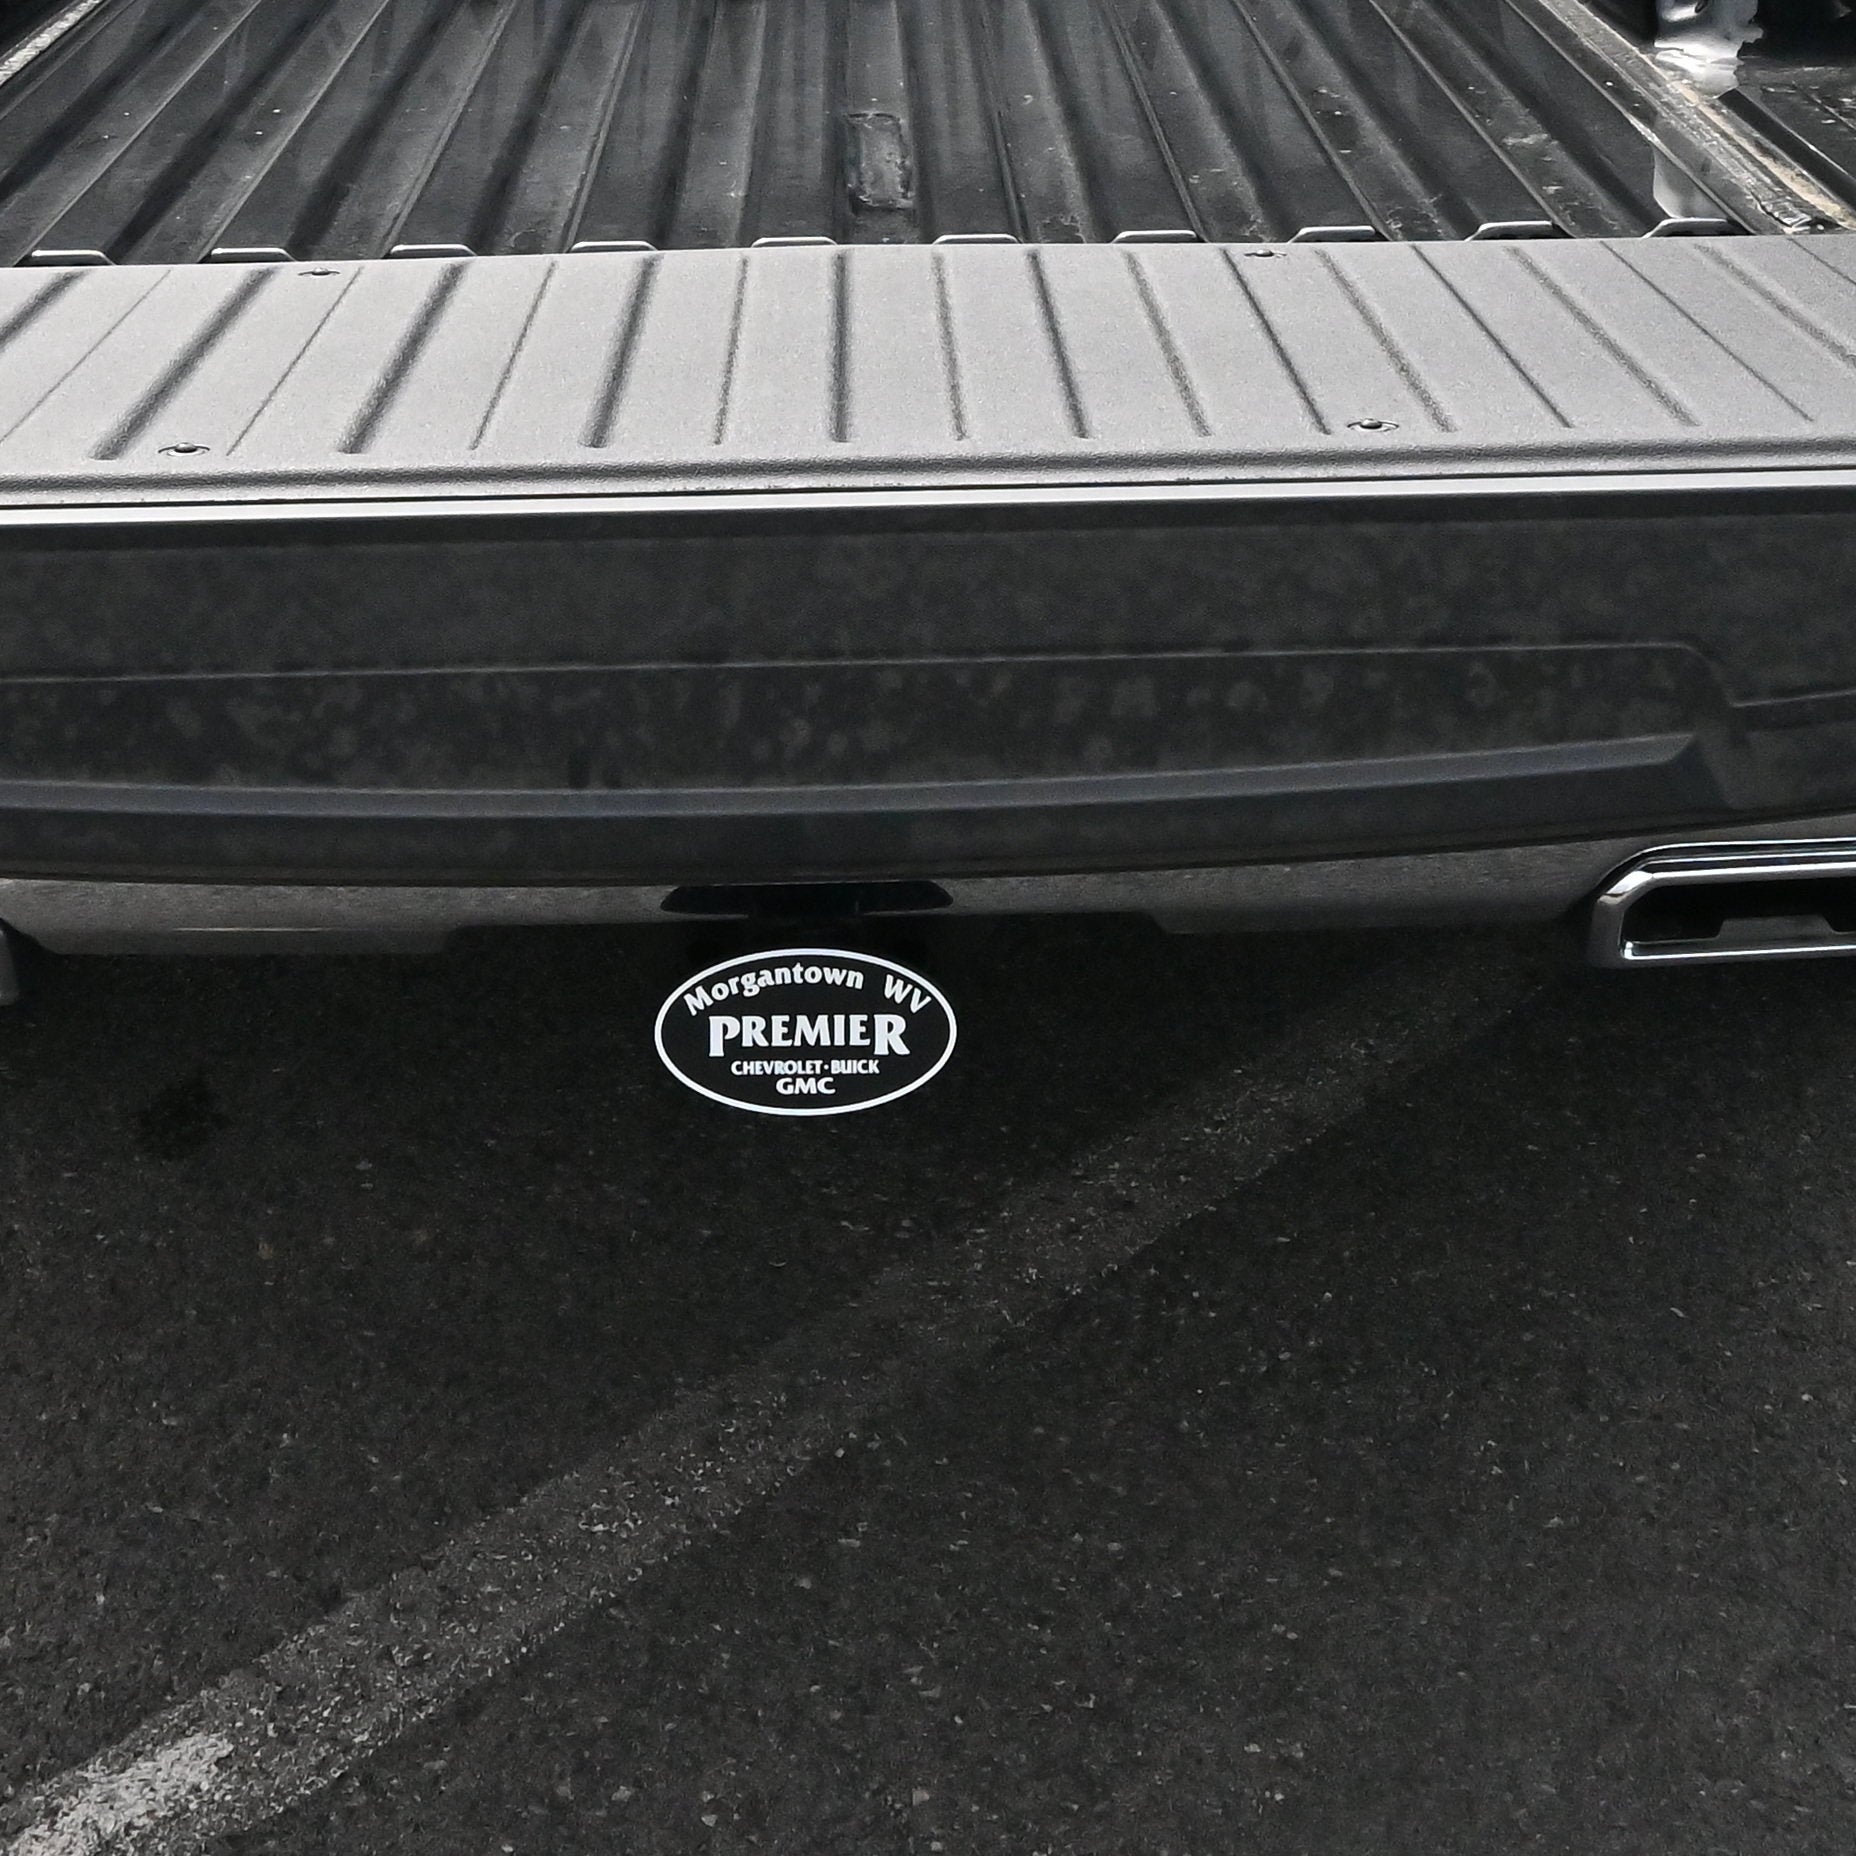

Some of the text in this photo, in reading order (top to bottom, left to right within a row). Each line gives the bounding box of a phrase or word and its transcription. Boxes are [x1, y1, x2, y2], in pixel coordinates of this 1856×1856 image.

[683, 962, 932, 1016] Morgantown WV
[708, 1013, 910, 1057] PREMIER
[730, 1059, 880, 1075] CHEVROLET BUICK
[775, 1077, 836, 1095] GMC
